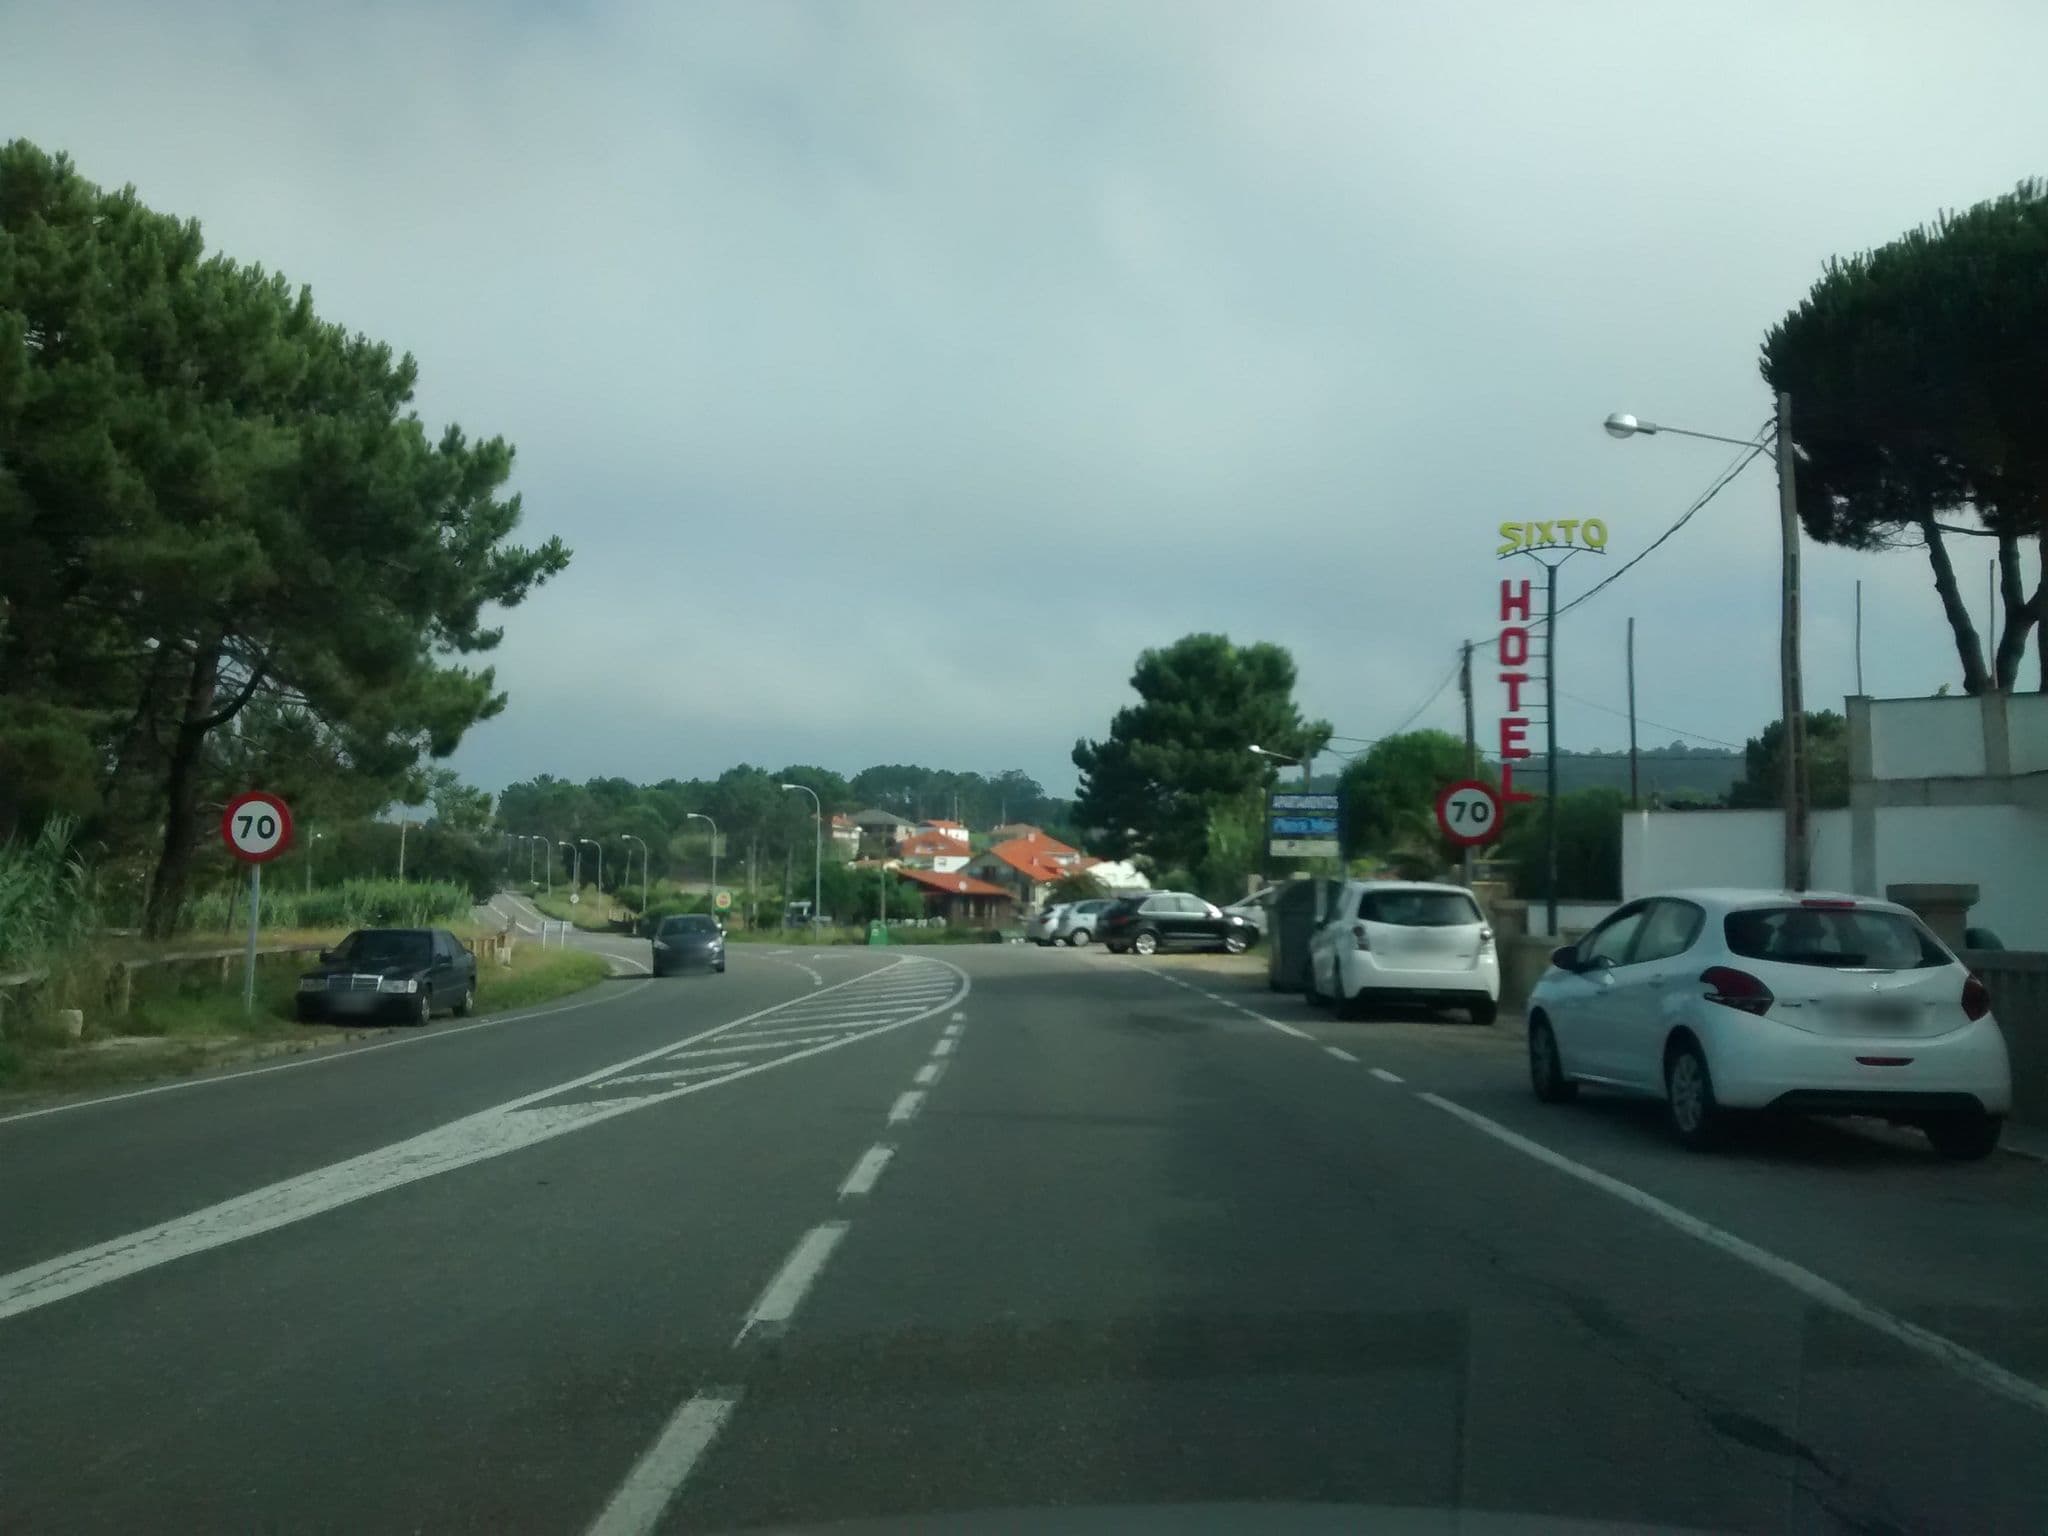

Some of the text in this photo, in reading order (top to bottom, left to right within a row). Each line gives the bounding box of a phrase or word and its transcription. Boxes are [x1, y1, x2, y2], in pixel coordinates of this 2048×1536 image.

[1497, 519, 1607, 554] SIXTO
[1499, 579, 1533, 803] HOTEL
[1452, 801, 1489, 823] 70
[237, 815, 276, 839] 70
